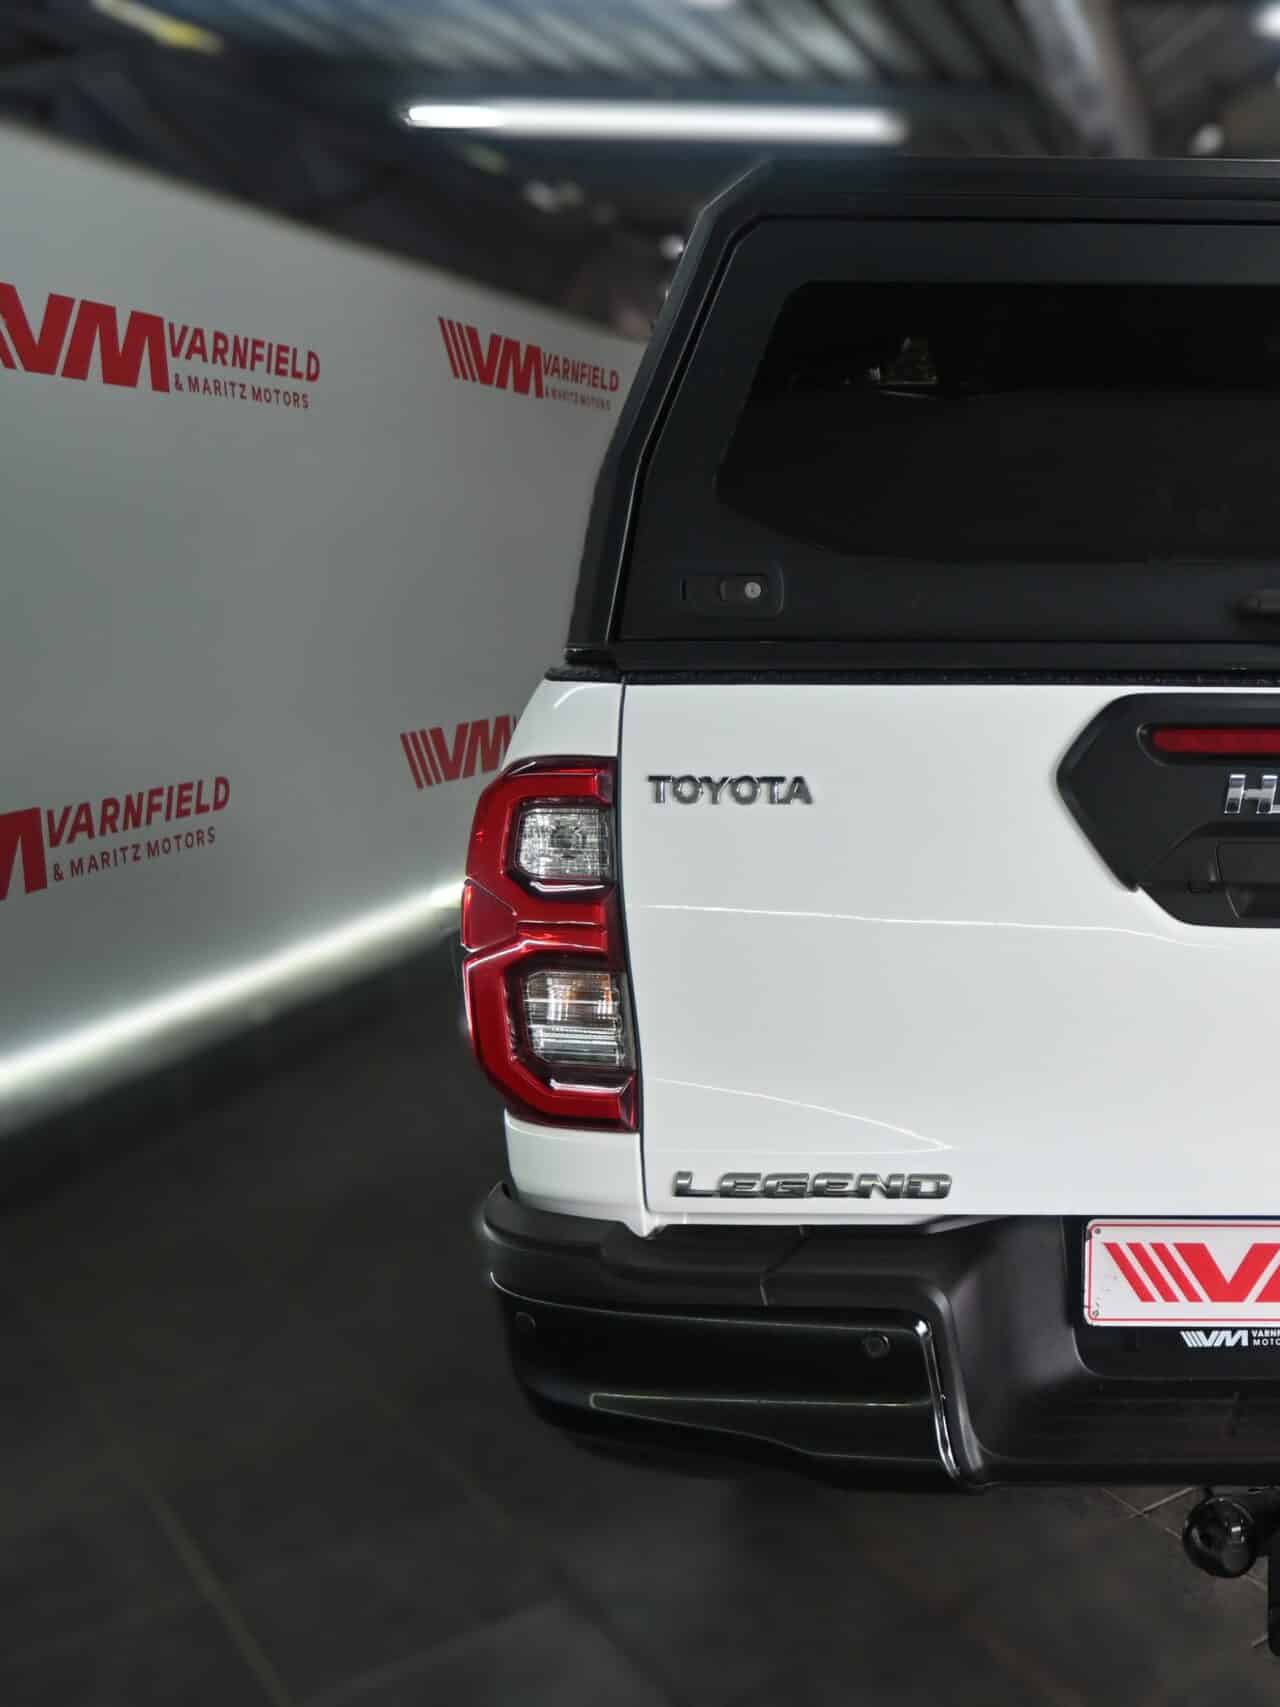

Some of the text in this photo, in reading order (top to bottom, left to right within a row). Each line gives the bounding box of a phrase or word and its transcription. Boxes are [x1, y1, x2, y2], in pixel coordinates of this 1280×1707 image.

[0, 282, 170, 393] VM
[168, 321, 321, 383] VARNFIELD
[464, 323, 544, 399] VM
[174, 373, 309, 409] & MARITZ MOTORS
[542, 351, 620, 392] VARNFIELD
[46, 776, 231, 848] VARNFIELD
[646, 774, 813, 805] TOYOTA
[53, 826, 217, 883] & MARITZ MOTORS
[672, 1169, 952, 1200] LEGEND
